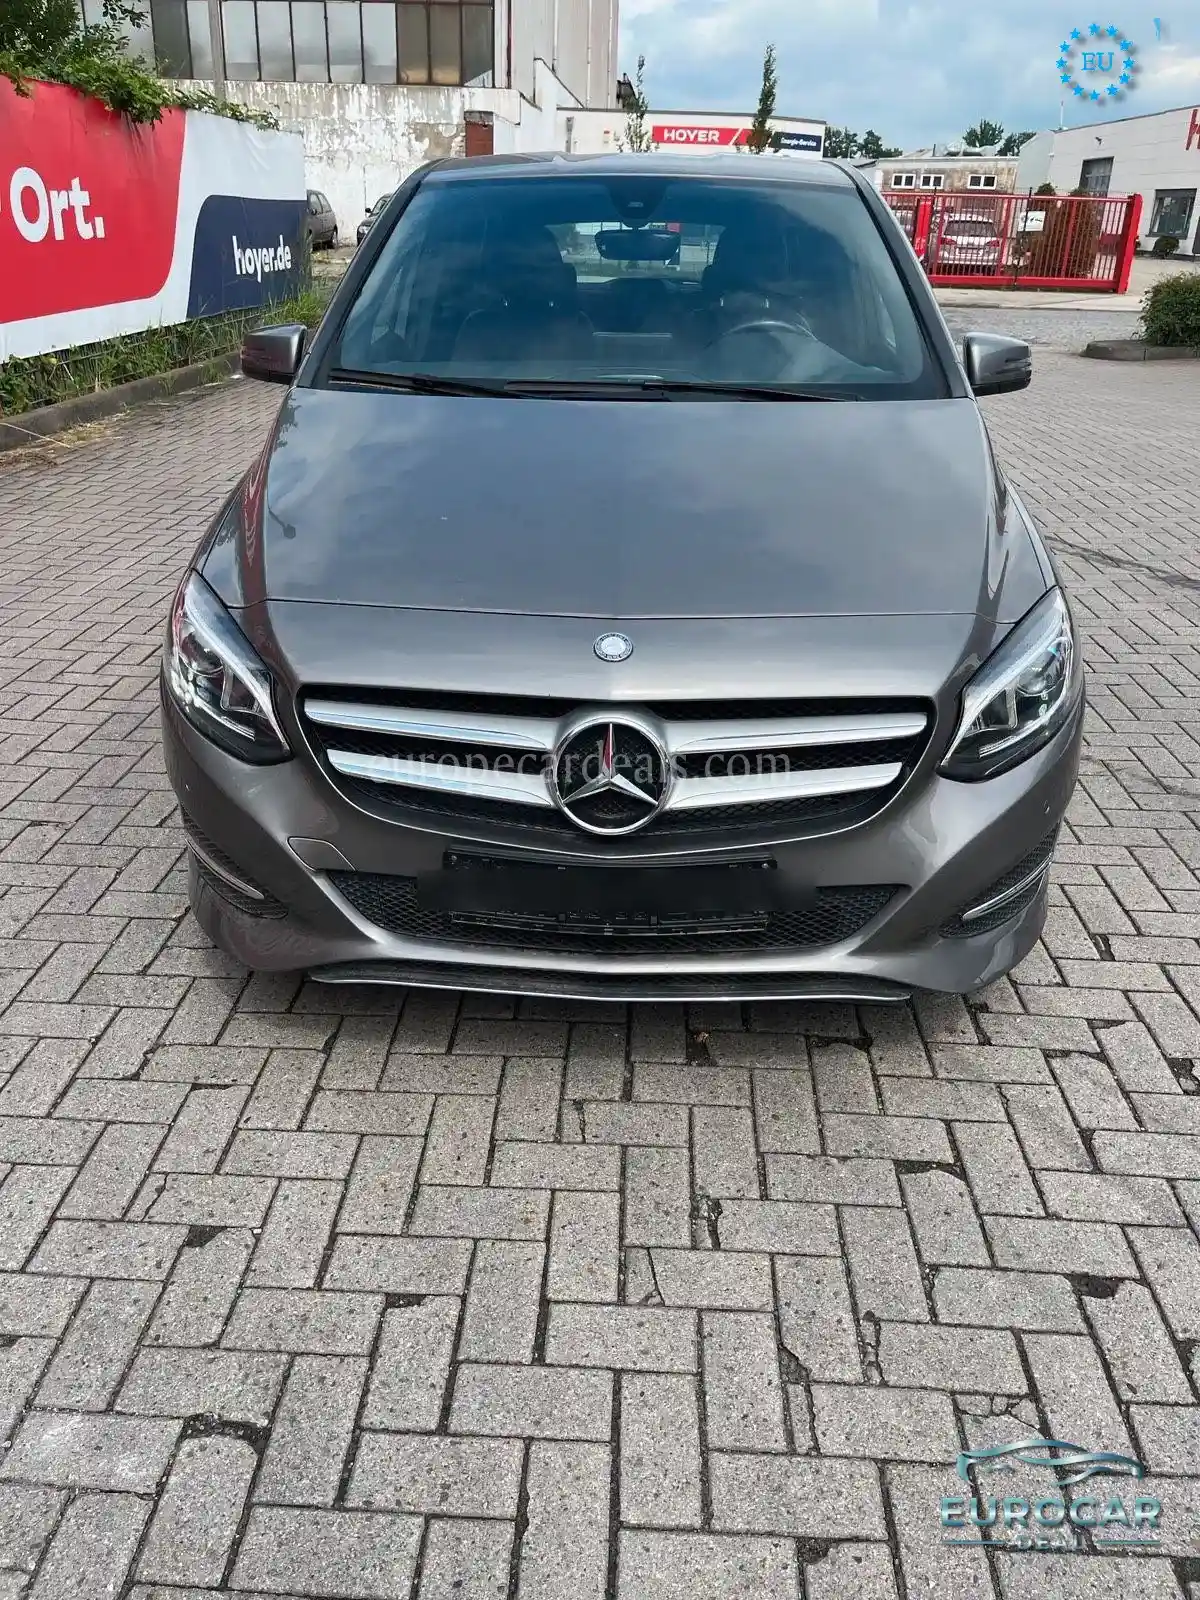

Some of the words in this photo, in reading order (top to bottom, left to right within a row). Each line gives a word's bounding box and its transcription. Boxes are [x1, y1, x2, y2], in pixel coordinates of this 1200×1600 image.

[663, 128, 720, 143] HOYER
[9, 166, 105, 243] Ort.
[232, 234, 292, 283] hoyer.de
